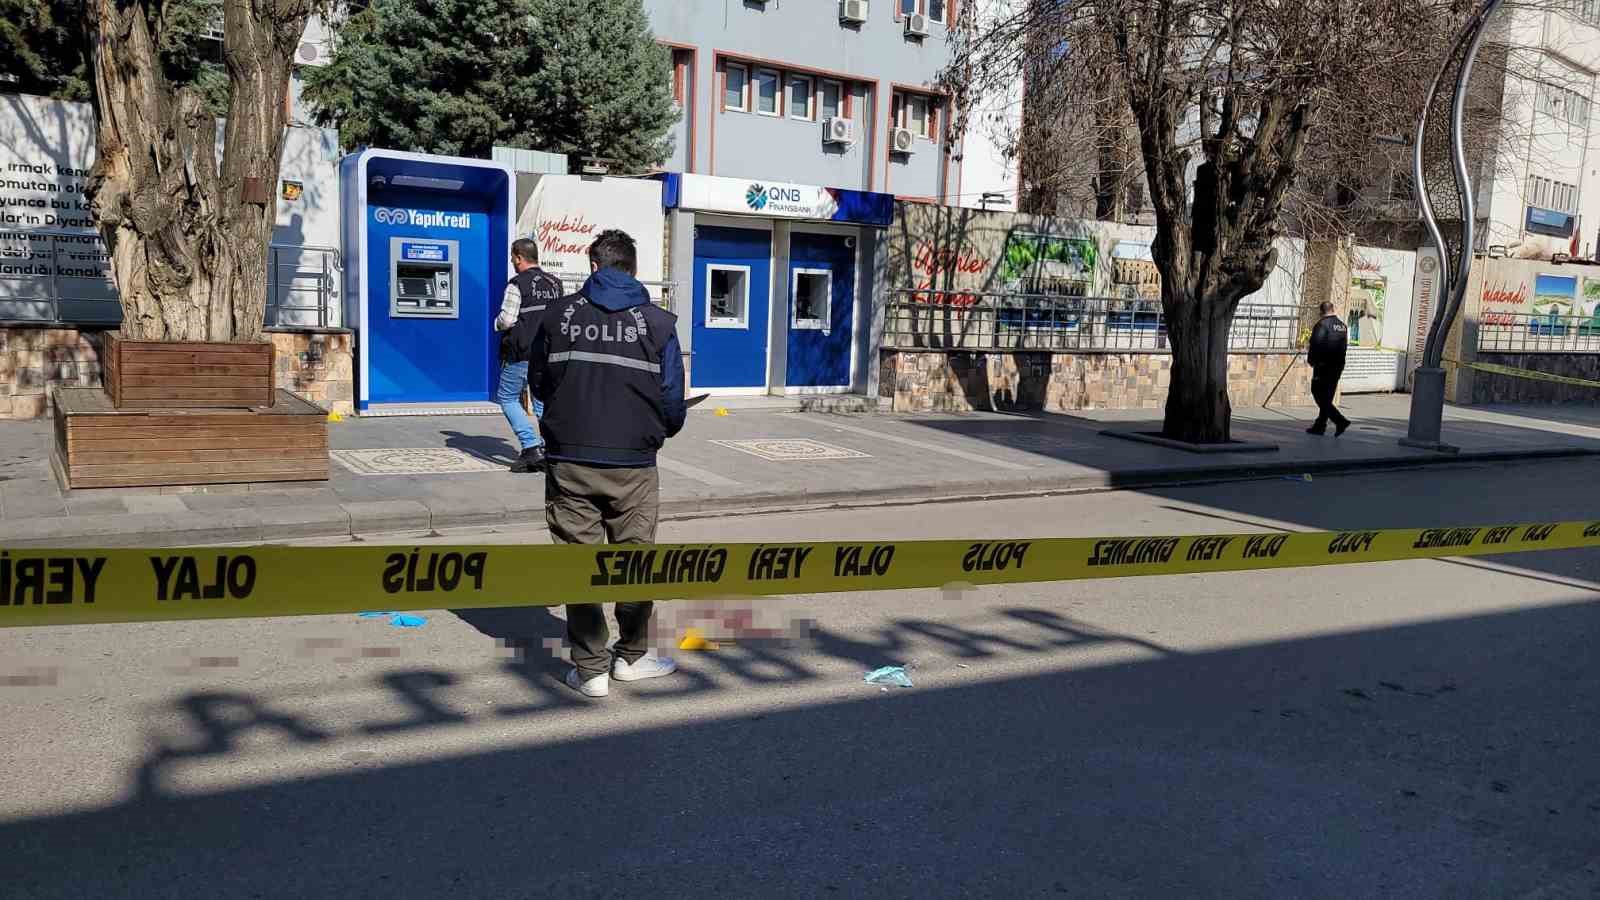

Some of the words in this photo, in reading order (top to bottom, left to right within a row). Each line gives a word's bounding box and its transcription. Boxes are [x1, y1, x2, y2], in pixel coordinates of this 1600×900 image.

[769, 187, 800, 202] QNB
[51, 199, 70, 209] bu
[45, 214, 94, 228] Diyarb
[408, 209, 471, 228] YapıKredi
[570, 320, 638, 343] POLİS
